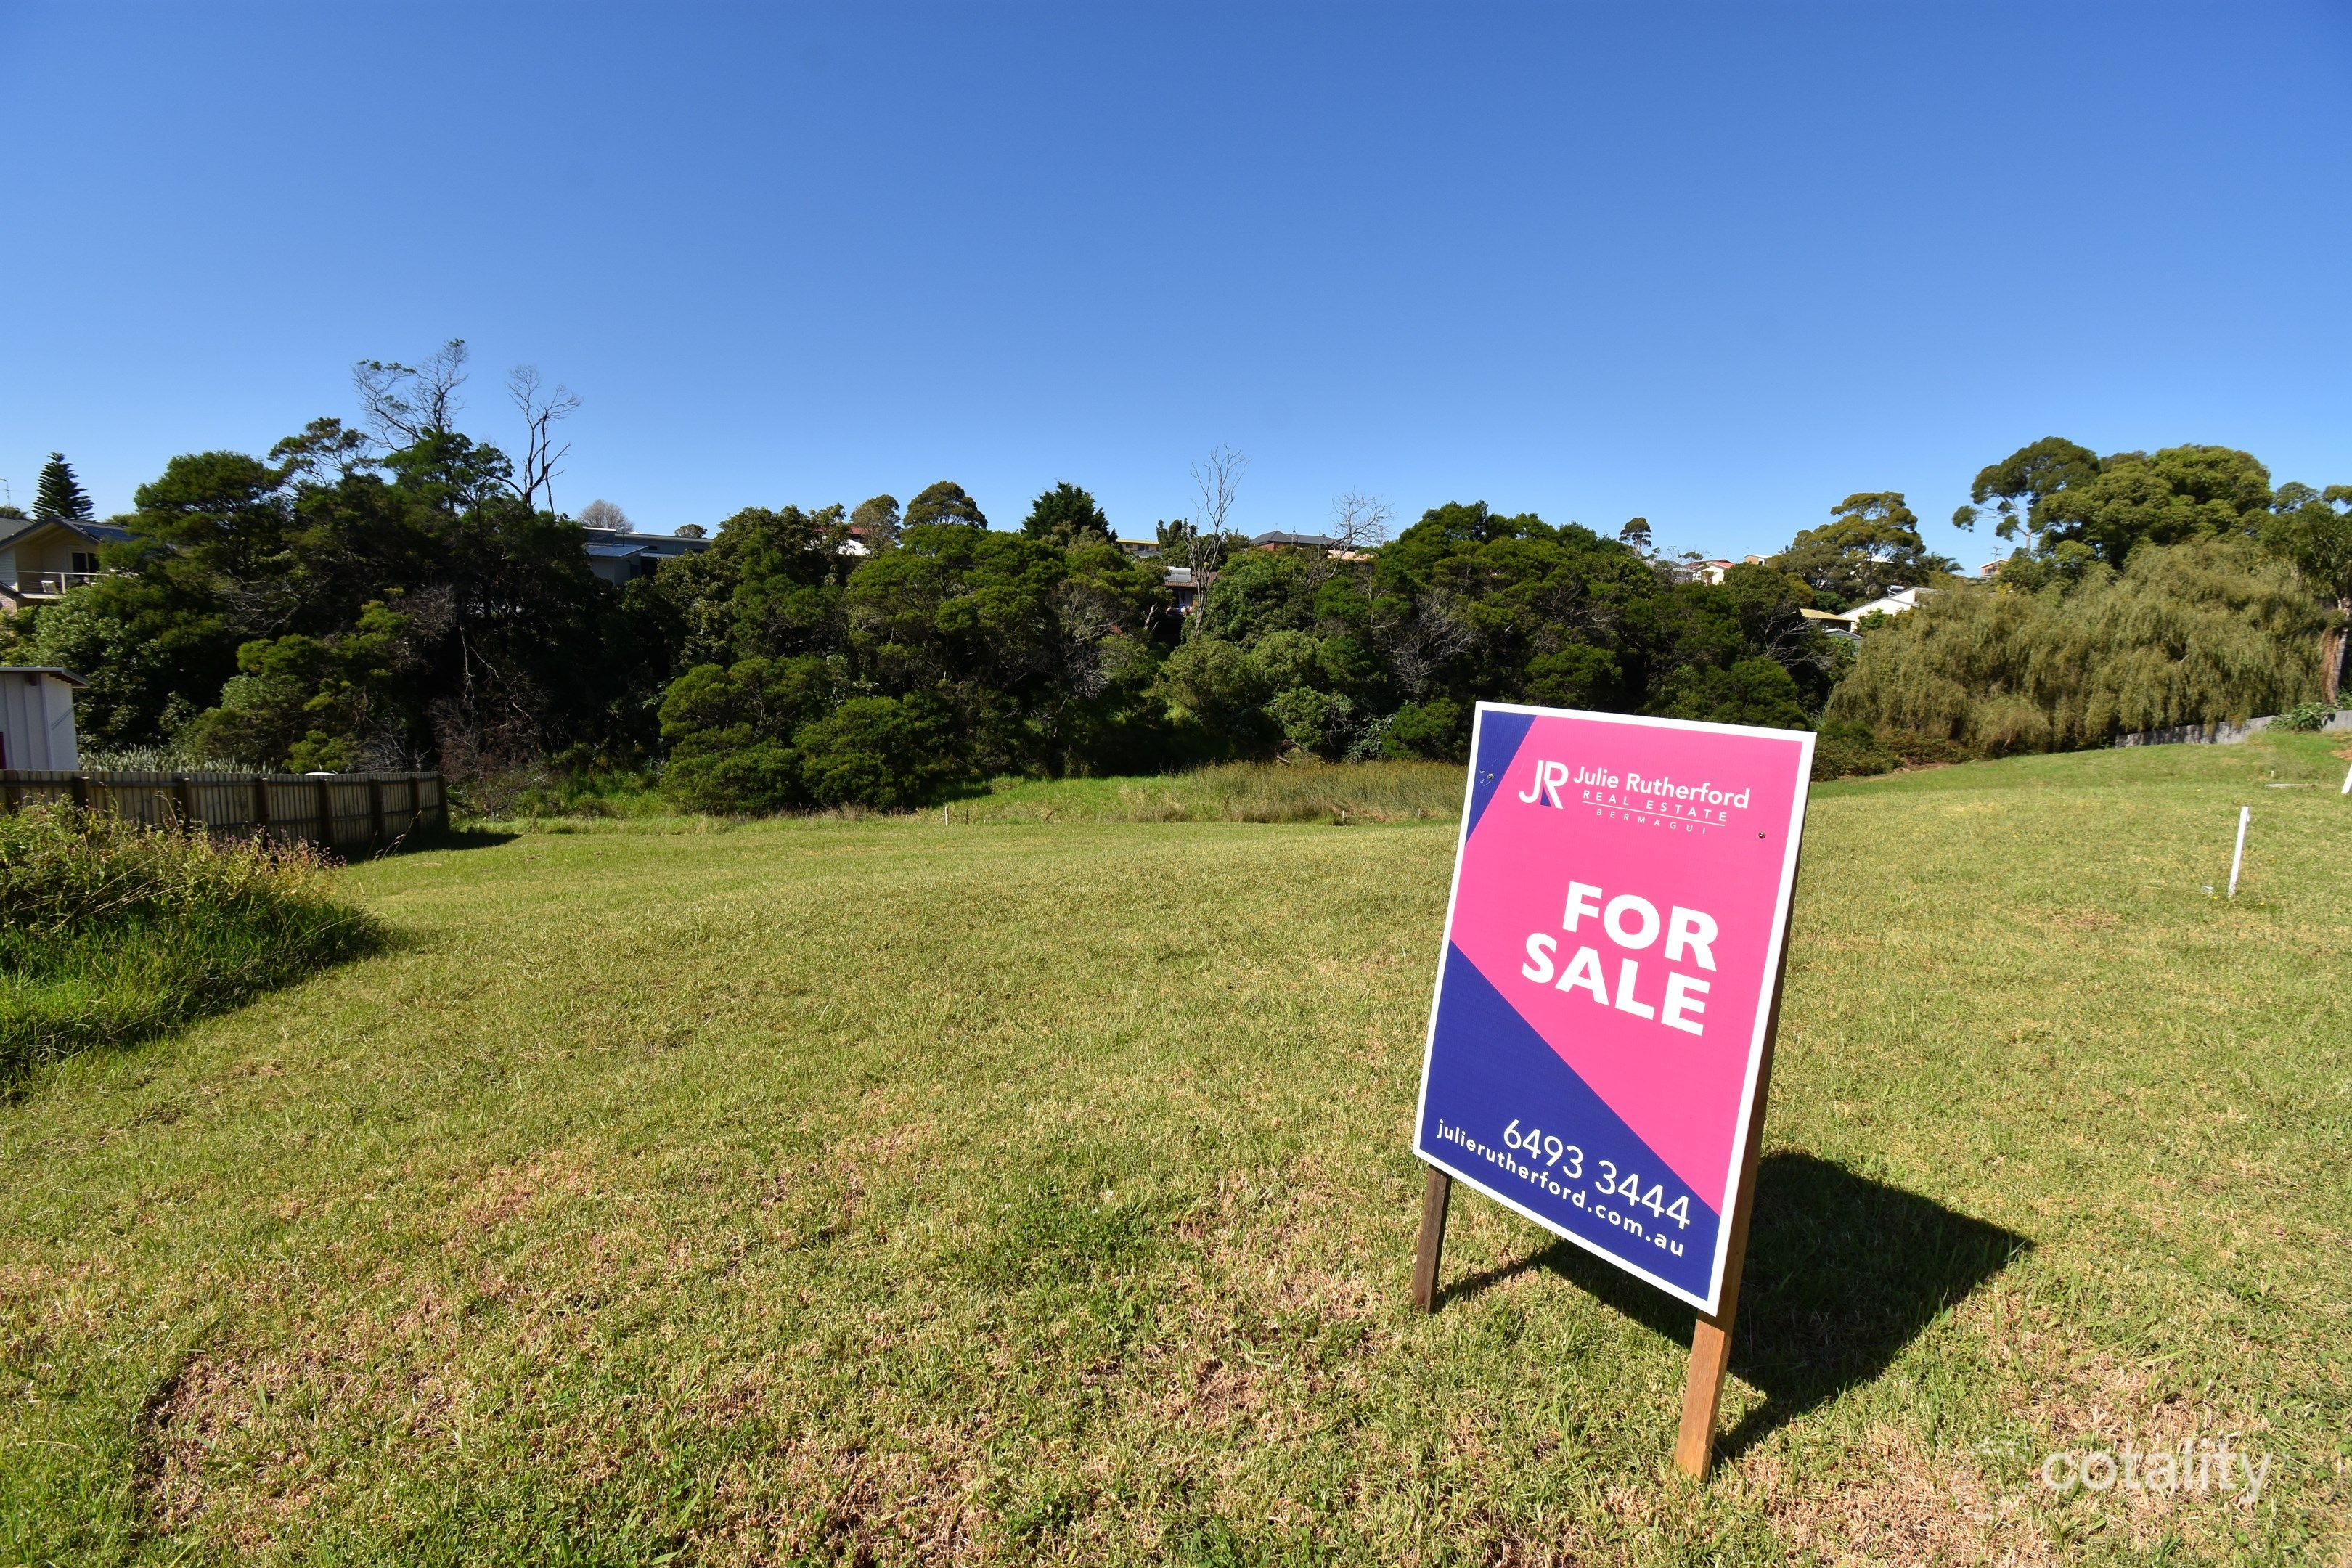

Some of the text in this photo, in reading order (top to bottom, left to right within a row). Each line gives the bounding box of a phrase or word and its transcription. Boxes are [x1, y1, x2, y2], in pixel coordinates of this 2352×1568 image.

[1518, 759, 1569, 809] JR
[1573, 766, 1751, 809] Julie Rutherford
[1583, 789, 1728, 822] REAL ESTATE
[1596, 809, 1706, 834] BERMAGUI
[1562, 881, 1718, 972] FOR
[1522, 932, 1710, 1037] SALE
[1436, 1119, 1684, 1257] julierutherford.com.au
[1503, 1119, 1691, 1230] 6493 3444
